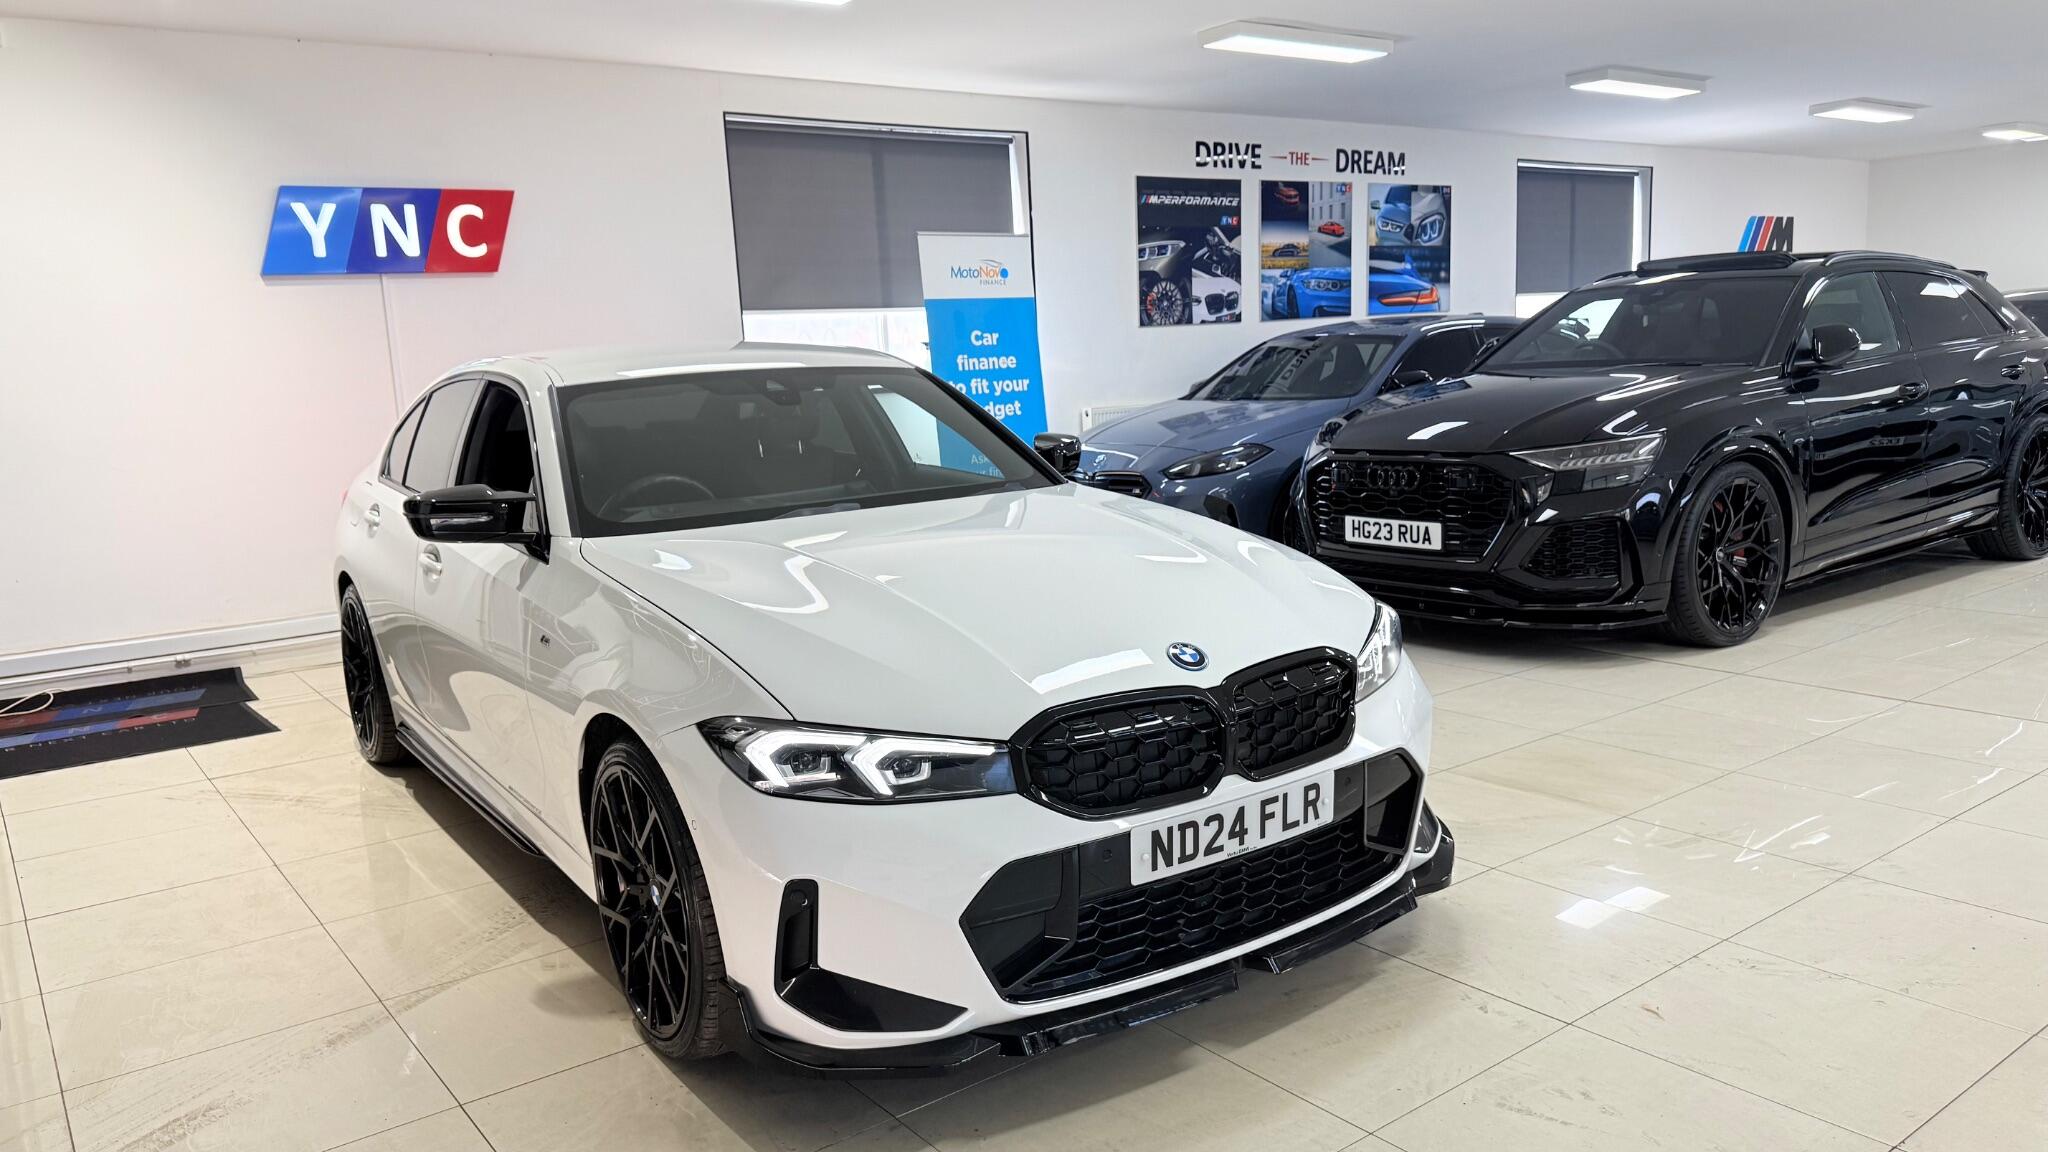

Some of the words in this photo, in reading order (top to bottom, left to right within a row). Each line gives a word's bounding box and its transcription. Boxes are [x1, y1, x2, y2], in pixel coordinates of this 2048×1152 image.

[1195, 140, 1262, 169] DRIVE
[1289, 151, 1310, 166] THE
[1335, 148, 1405, 176] DREAM
[290, 201, 488, 258] YNC
[970, 330, 999, 346] Car
[956, 354, 1017, 371] finance
[970, 377, 990, 395] fit
[993, 378, 1030, 397] your
[984, 400, 1022, 420] dget
[1352, 519, 1393, 541] HG23
[1398, 523, 1432, 545] RUA
[1151, 805, 1248, 872] ND24
[1260, 782, 1321, 839] FLR
